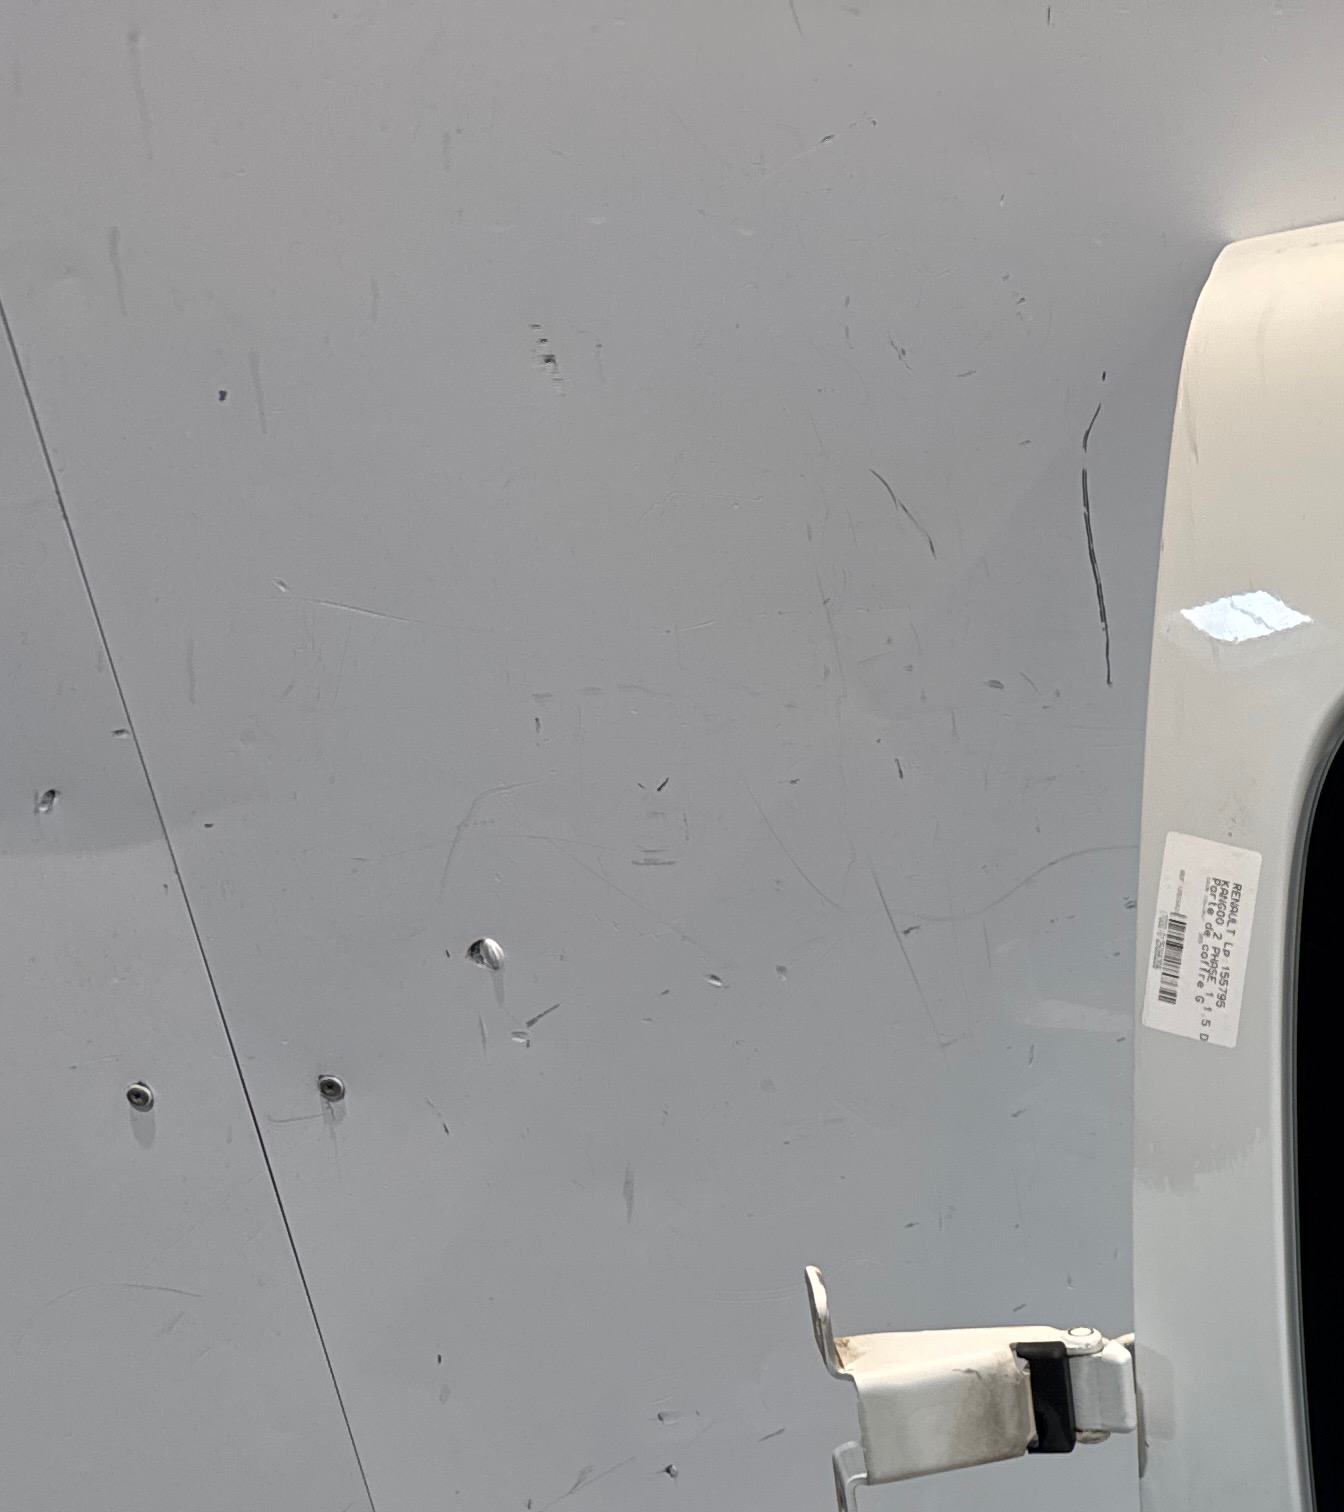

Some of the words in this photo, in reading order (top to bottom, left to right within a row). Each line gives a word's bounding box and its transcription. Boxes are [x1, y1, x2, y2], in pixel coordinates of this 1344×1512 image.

[1207, 877, 1220, 916] Porte
[1215, 880, 1229, 926] KANGOO
[1226, 883, 1242, 937] RENAULT
[1203, 921, 1213, 938] de
[1212, 932, 1222, 940] 2
[1197, 944, 1209, 989] coffre
[1207, 946, 1220, 985] PHASE
[1195, 995, 1204, 1004] G
[1216, 966, 1230, 1009] 155795
[1199, 1033, 1209, 1042] D
